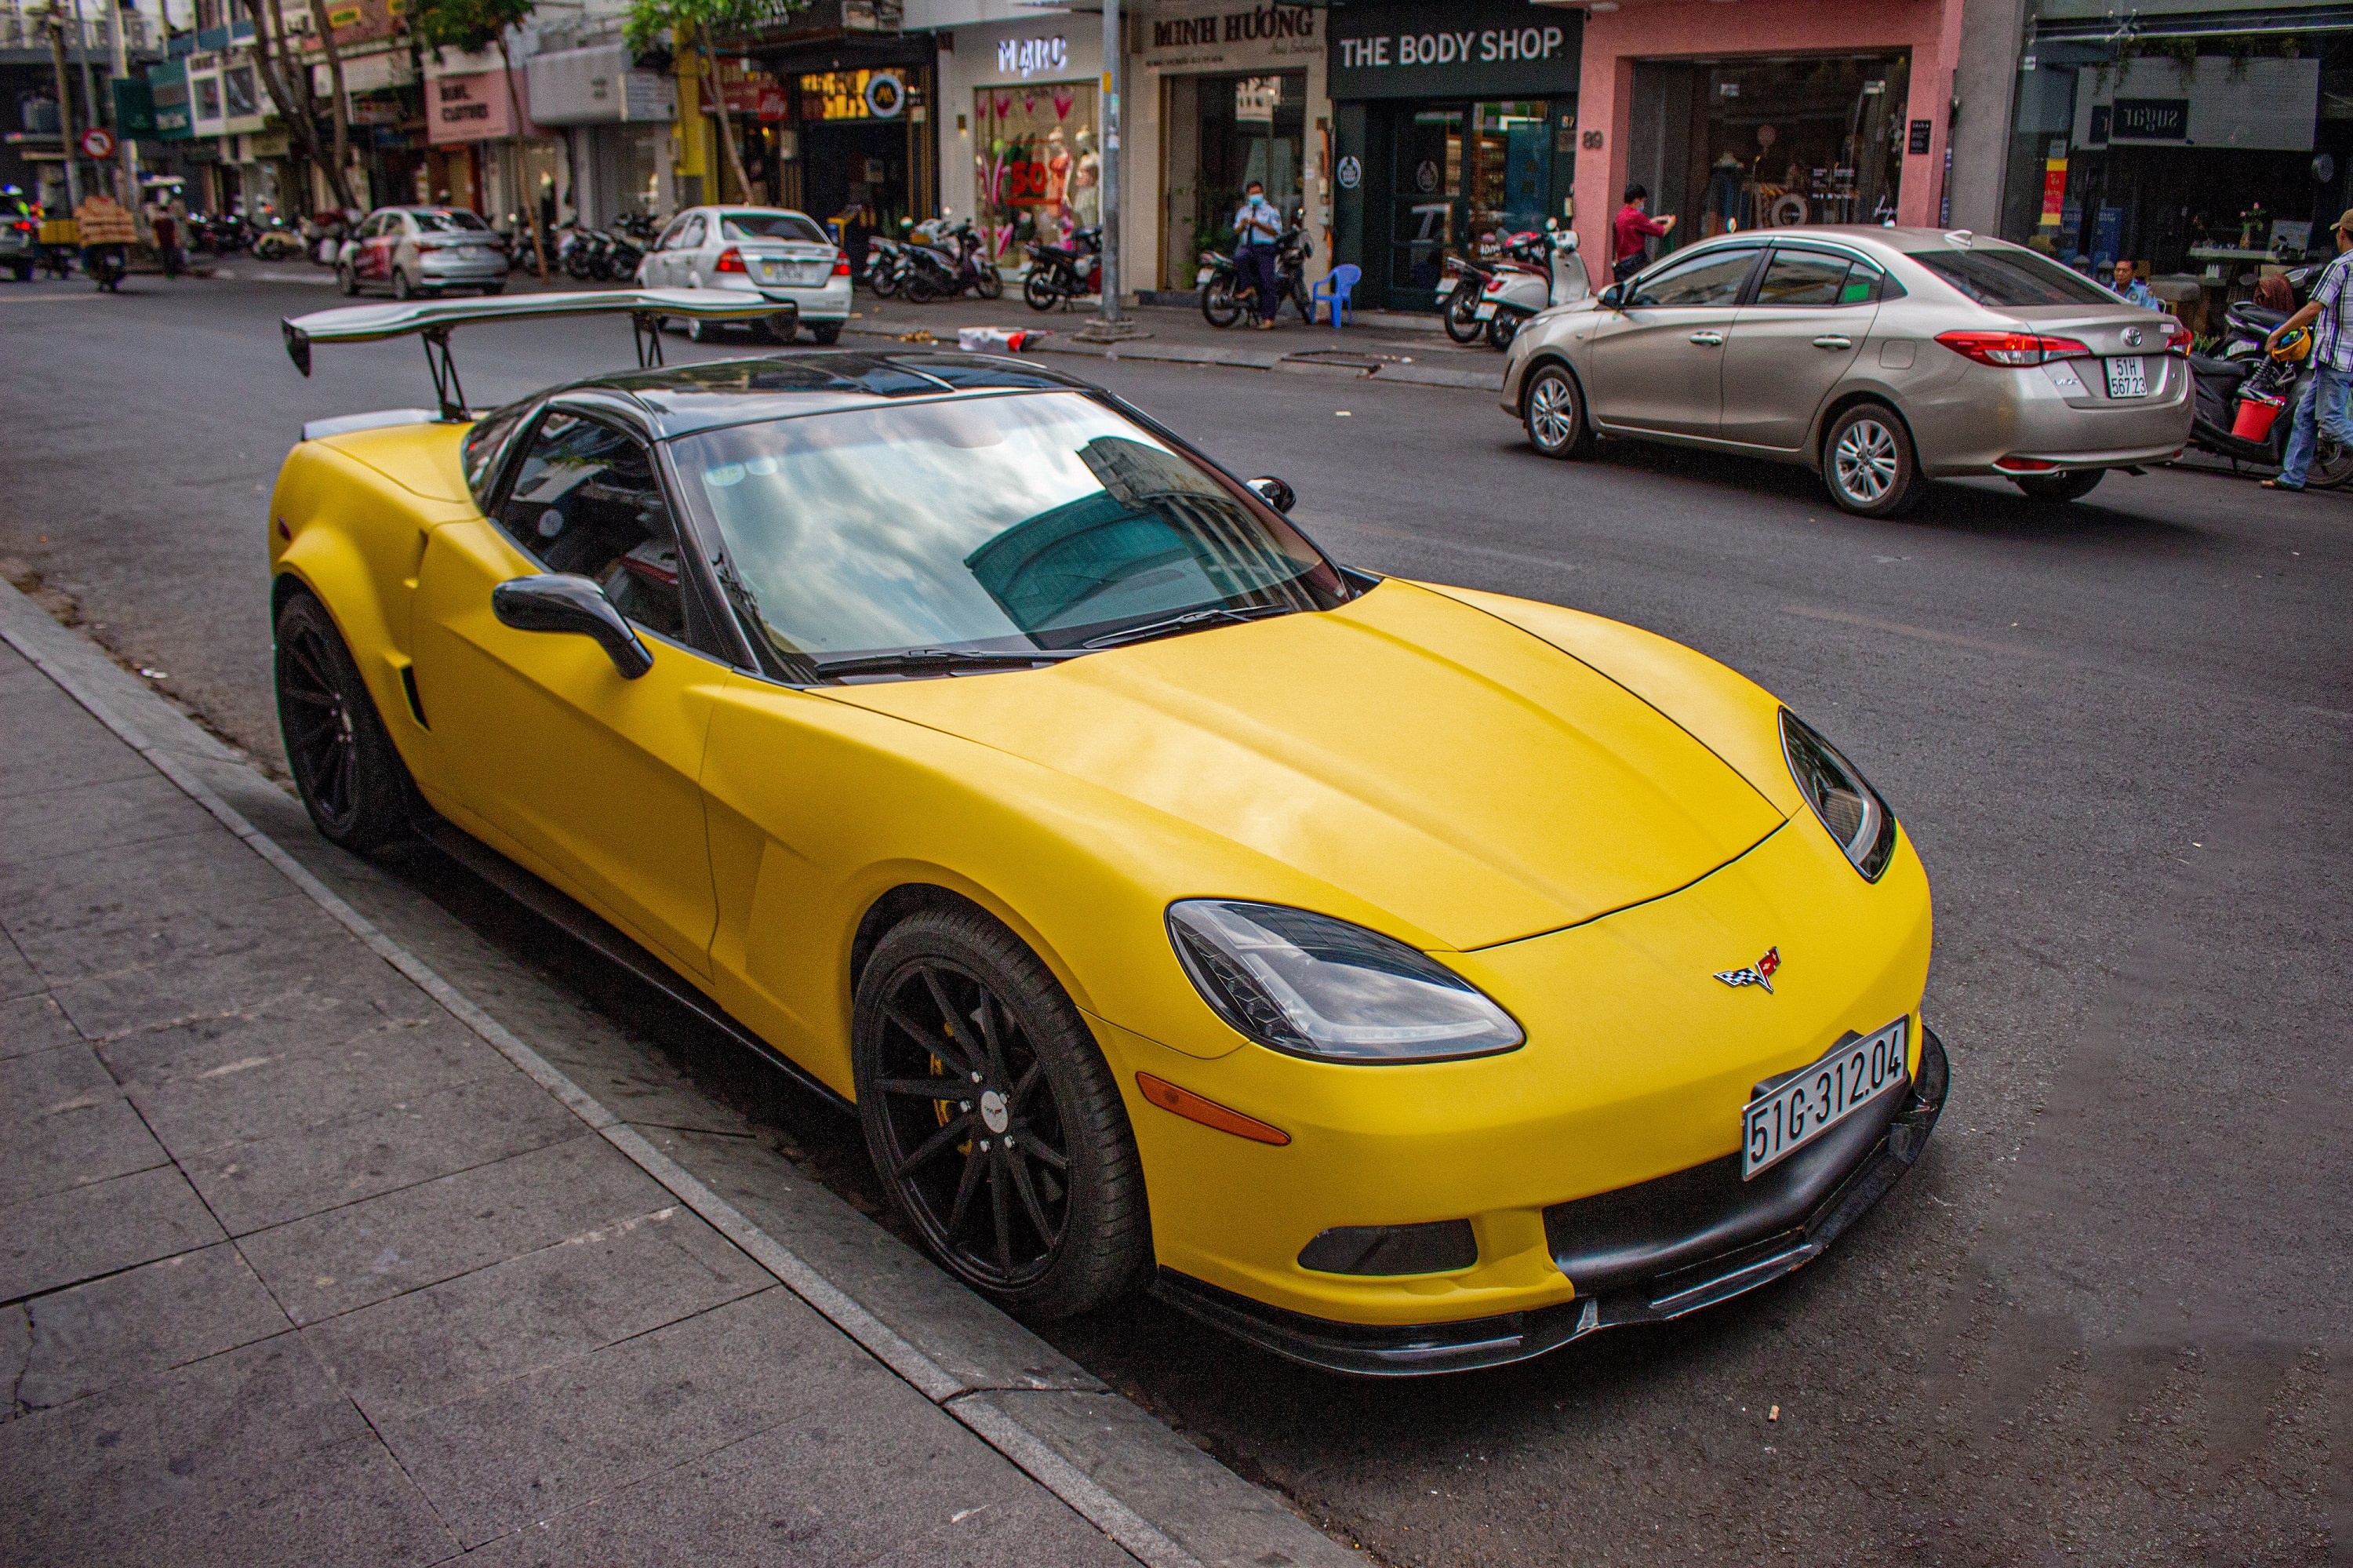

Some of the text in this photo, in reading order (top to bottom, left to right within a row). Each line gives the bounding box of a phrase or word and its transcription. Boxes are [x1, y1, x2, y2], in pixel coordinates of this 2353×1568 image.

[1153, 16, 1217, 47] MINH
[1340, 35, 1391, 67] THE
[1399, 31, 1475, 65] BODY
[1480, 26, 1563, 62] SHOP
[998, 37, 1066, 78] MARC
[1583, 129, 1604, 150] 89
[1011, 161, 1047, 194] 50
[2117, 358, 2137, 377] 51H
[2111, 377, 2146, 395] 567.23
[1750, 1029, 1901, 1164] 51G-312.04
